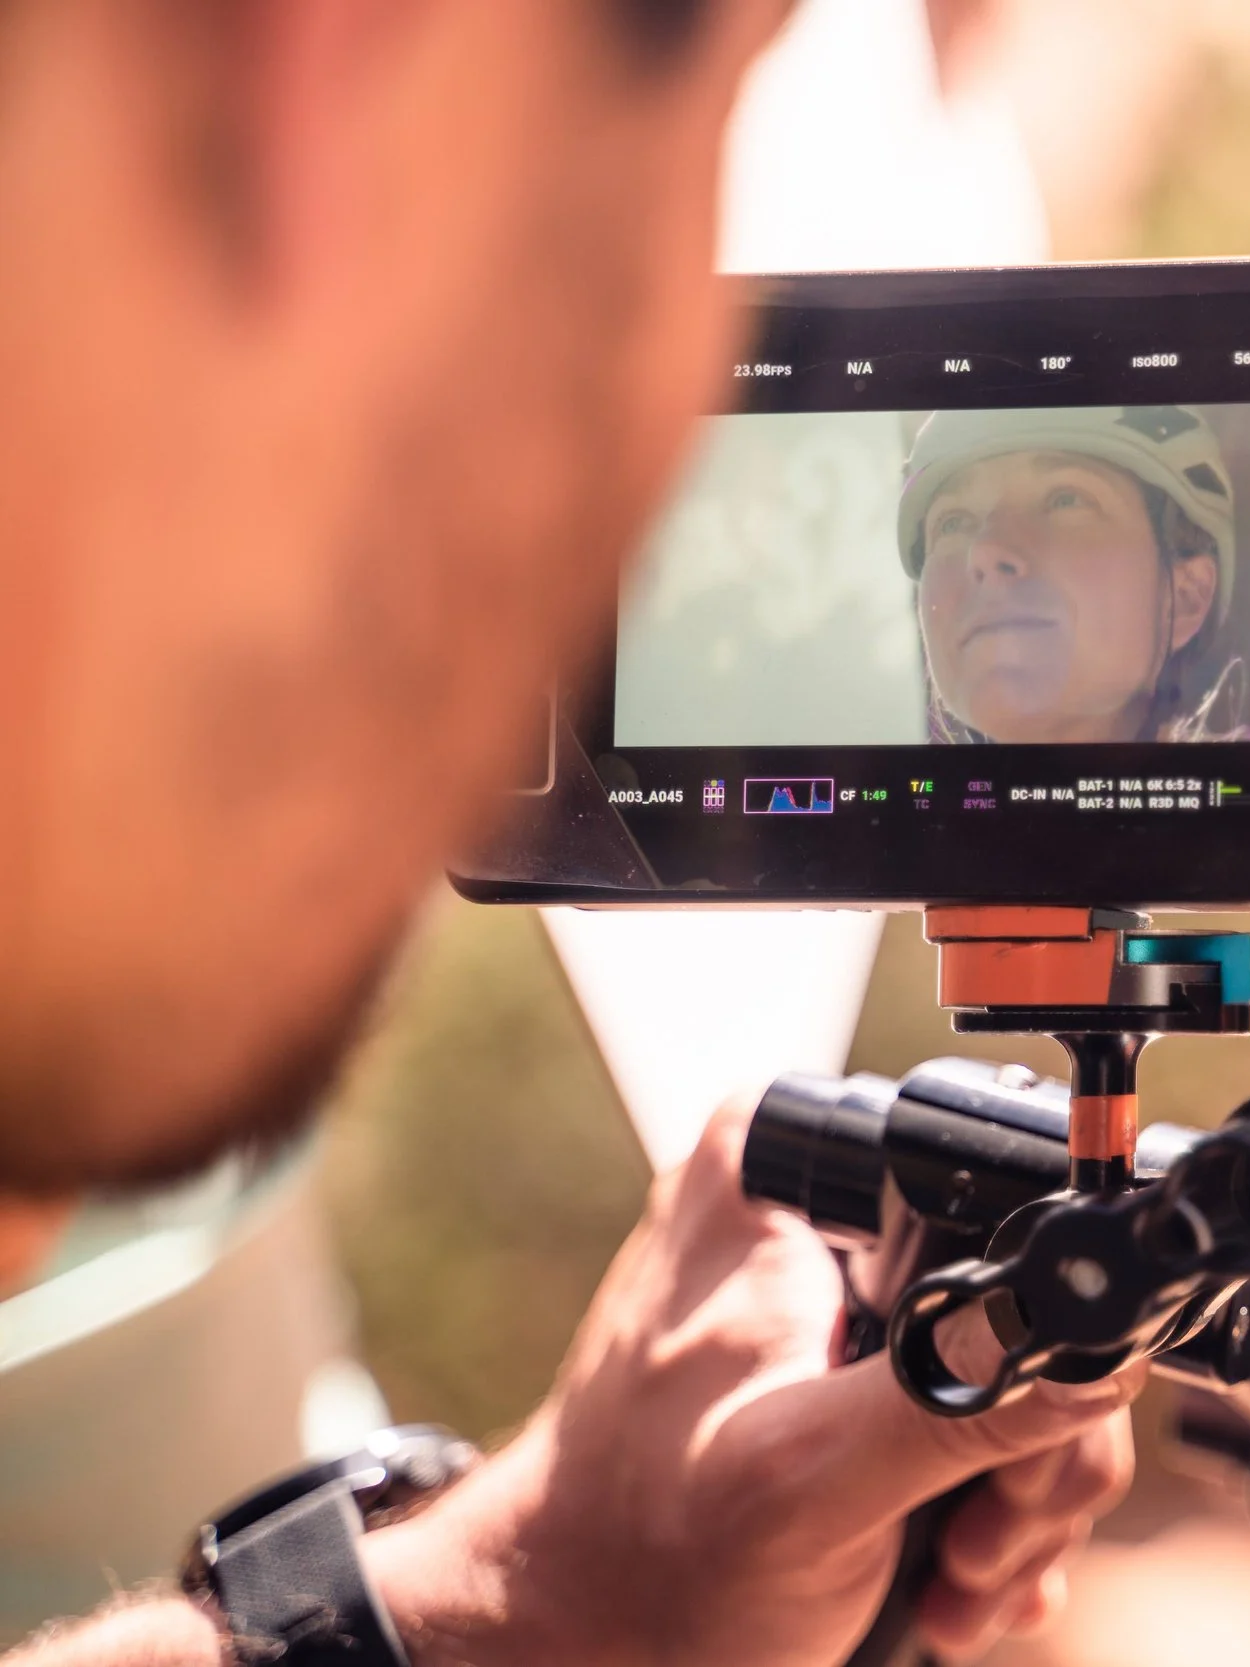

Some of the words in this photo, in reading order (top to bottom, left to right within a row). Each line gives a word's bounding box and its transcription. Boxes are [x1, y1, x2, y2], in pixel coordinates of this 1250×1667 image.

[733, 363, 792, 377] 23.98FPS
[847, 361, 873, 375] N/A
[944, 359, 971, 373] N/A
[1041, 356, 1072, 370] 180°
[910, 781, 934, 793] T/E
[967, 781, 993, 792] GEN
[1078, 780, 1113, 792] BAT-1
[1119, 780, 1143, 792] N/A
[1147, 779, 1164, 791] 6K
[1165, 779, 1185, 791] 6:5
[608, 790, 684, 805] A003_A045
[840, 790, 856, 802] CF
[862, 790, 887, 802] 1:49
[1011, 788, 1046, 801] DC-IN
[1052, 788, 1075, 801] N/A
[913, 798, 930, 810] TC
[963, 798, 997, 810] SYNC
[1078, 797, 1114, 809] BAT-2
[1119, 797, 1143, 809] N/A
[1149, 797, 1174, 809] R3D
[1178, 797, 1200, 810] MQ
